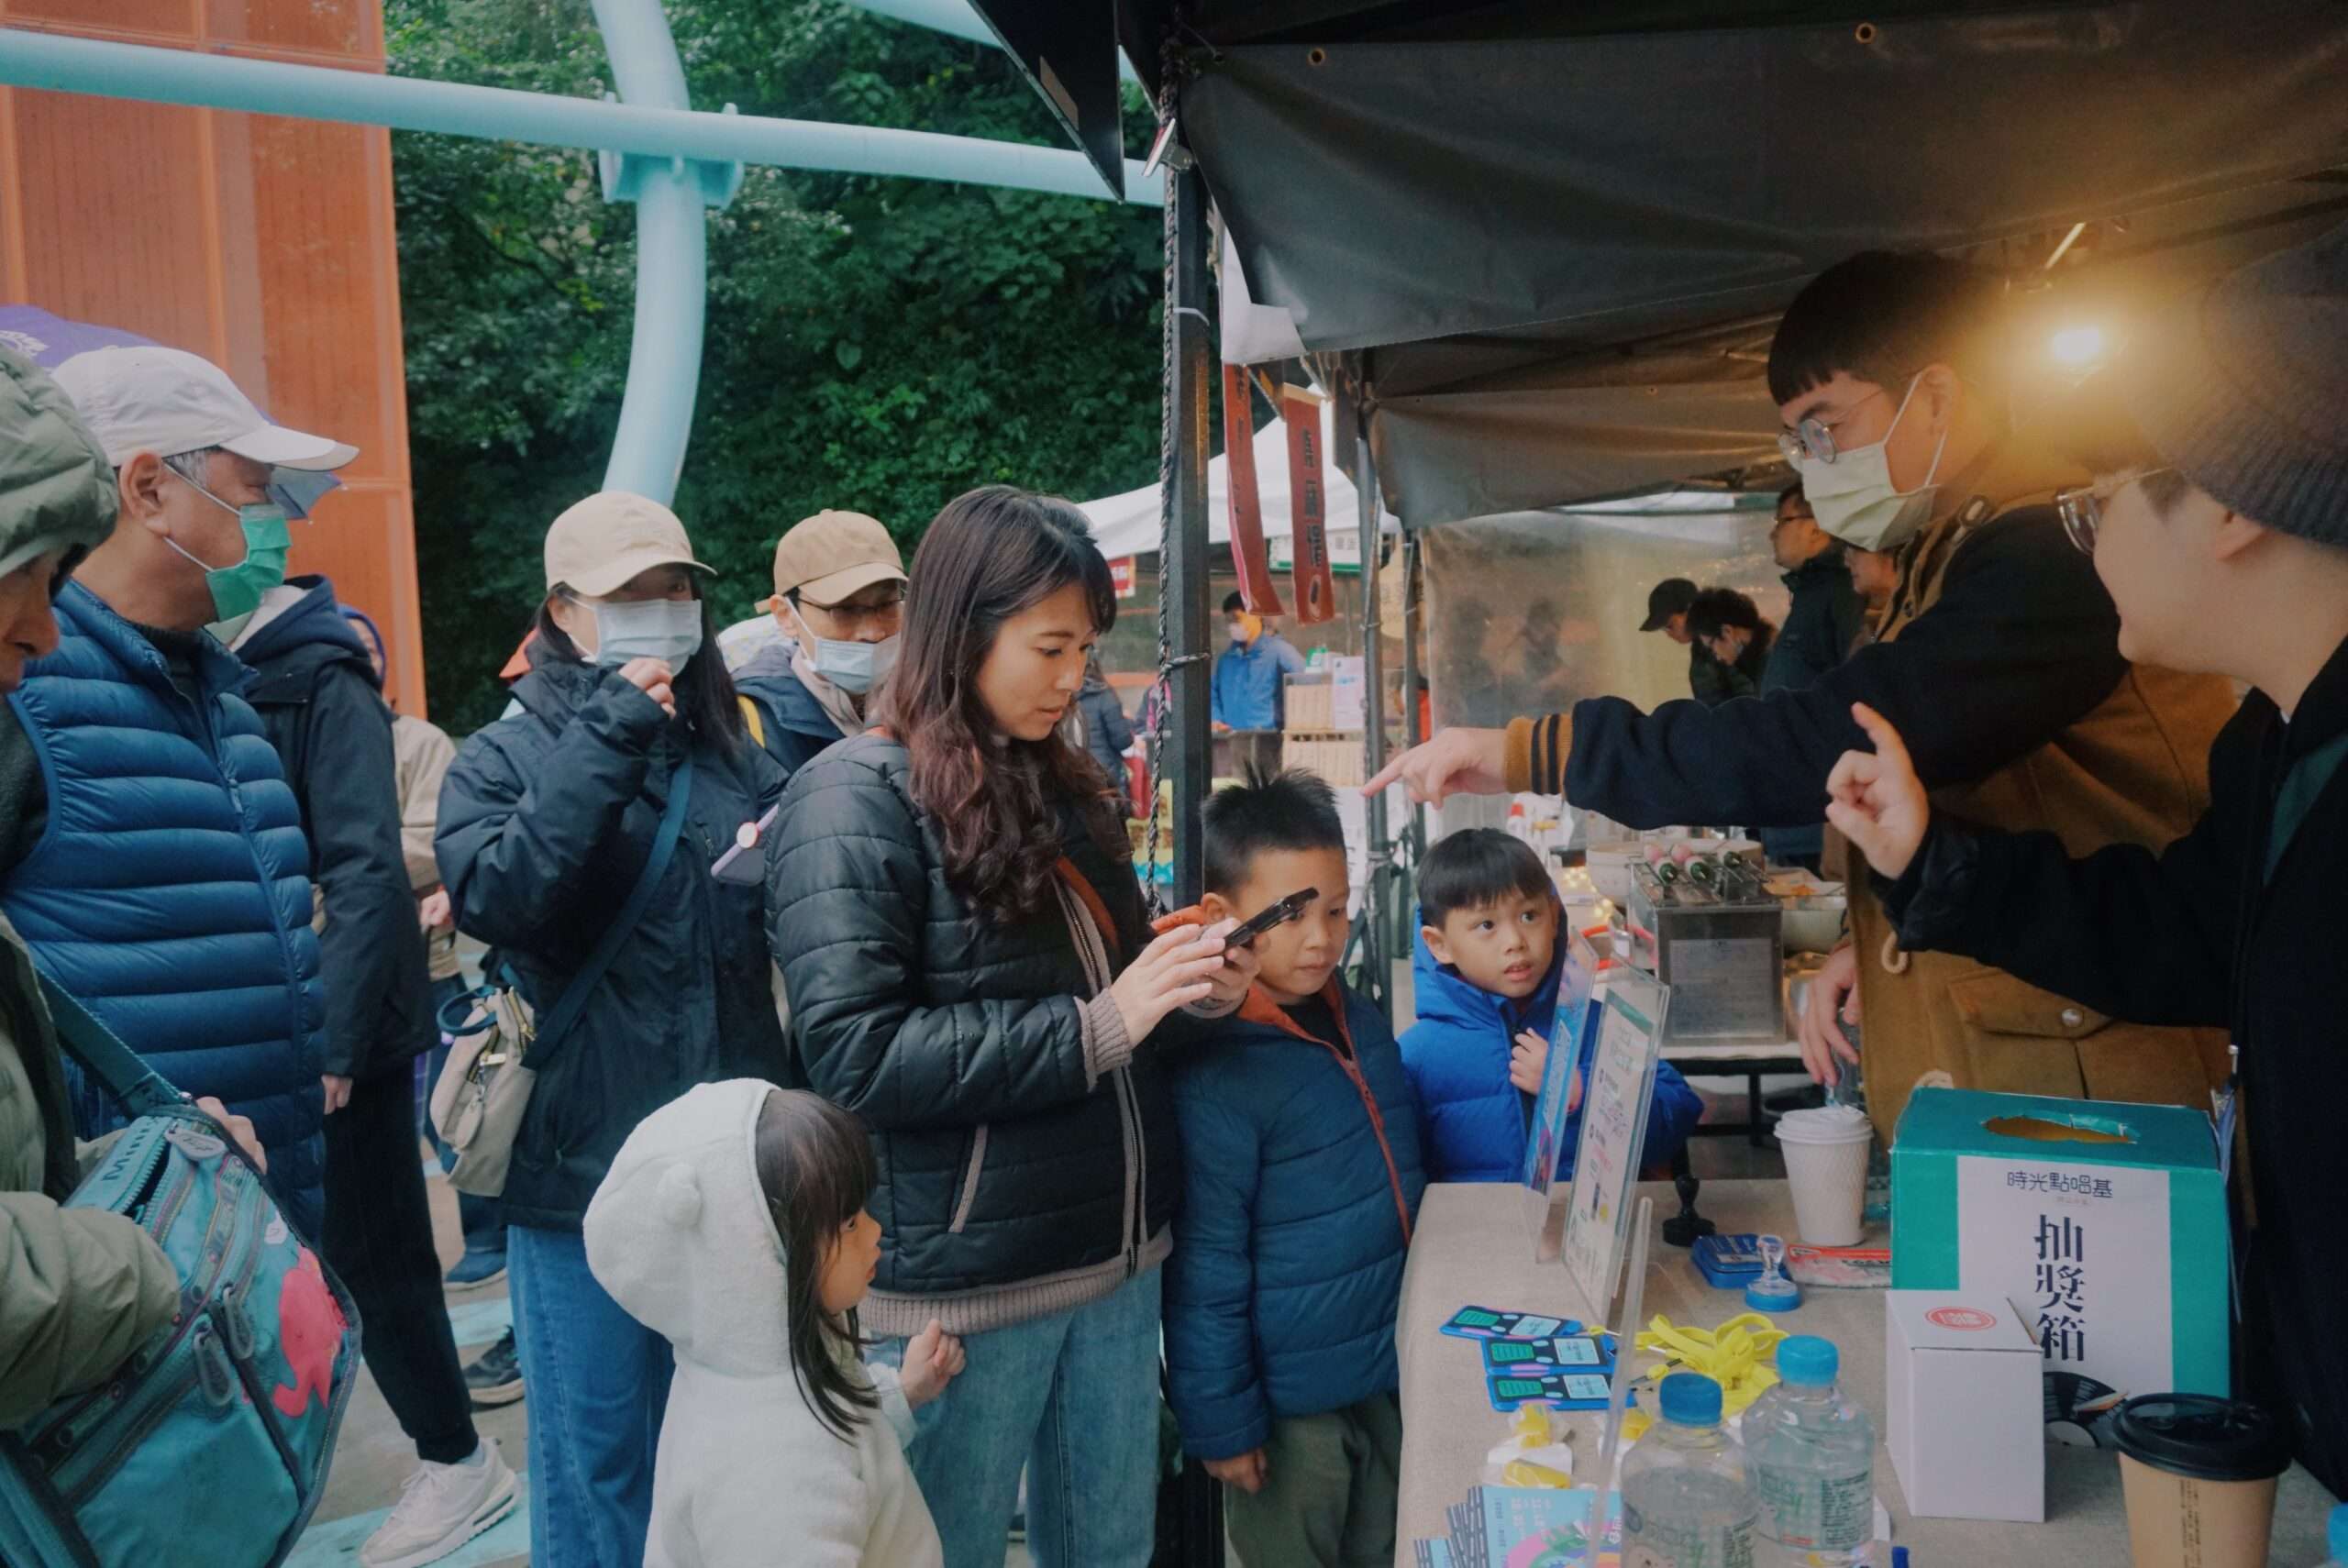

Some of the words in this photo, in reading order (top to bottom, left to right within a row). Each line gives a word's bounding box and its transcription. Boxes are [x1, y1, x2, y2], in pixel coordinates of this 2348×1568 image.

[2007, 1170, 2113, 1198] 時光點唱基
[2033, 1214, 2087, 1362] 抽獎箱
